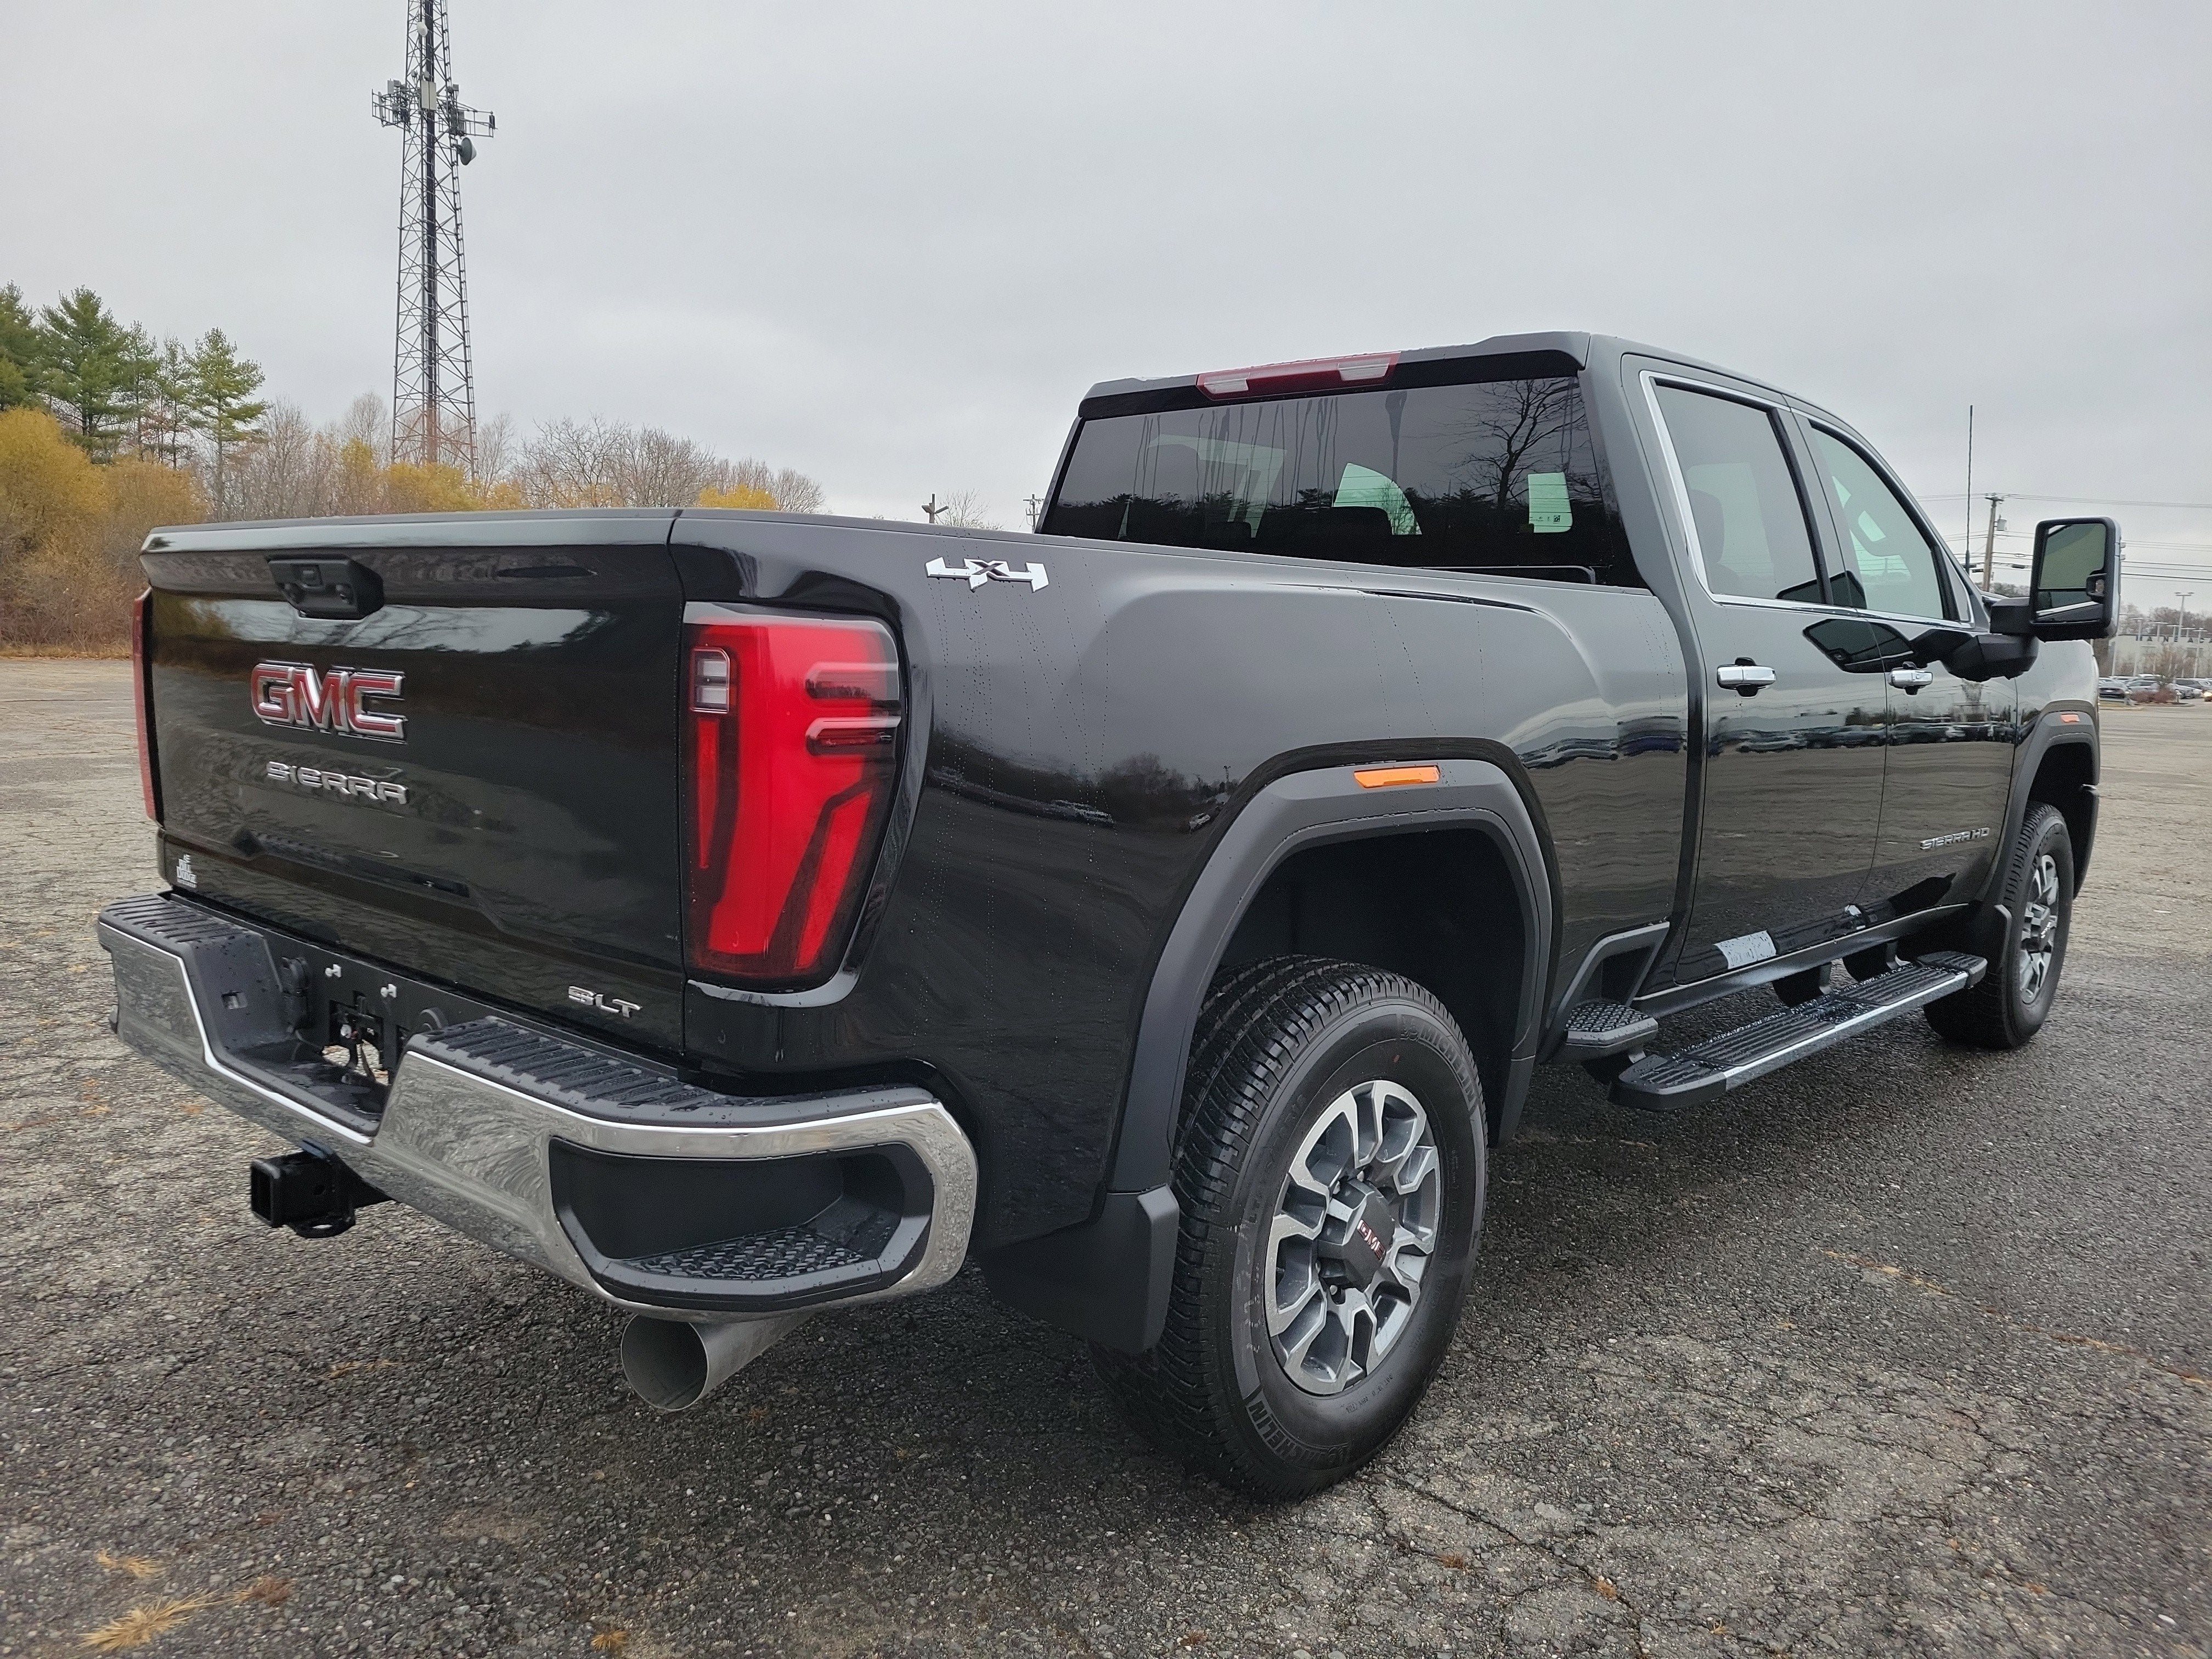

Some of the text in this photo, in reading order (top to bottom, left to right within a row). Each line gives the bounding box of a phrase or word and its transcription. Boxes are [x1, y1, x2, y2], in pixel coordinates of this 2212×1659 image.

[251, 659, 408, 744] GMC
[266, 761, 409, 805] SIERRA
[1920, 827, 1990, 850] SIERRA HD
[568, 986, 643, 1018] SLT
[1418, 1024, 1478, 1111] MICHELIN
[1357, 1219, 1386, 1261] GMC
